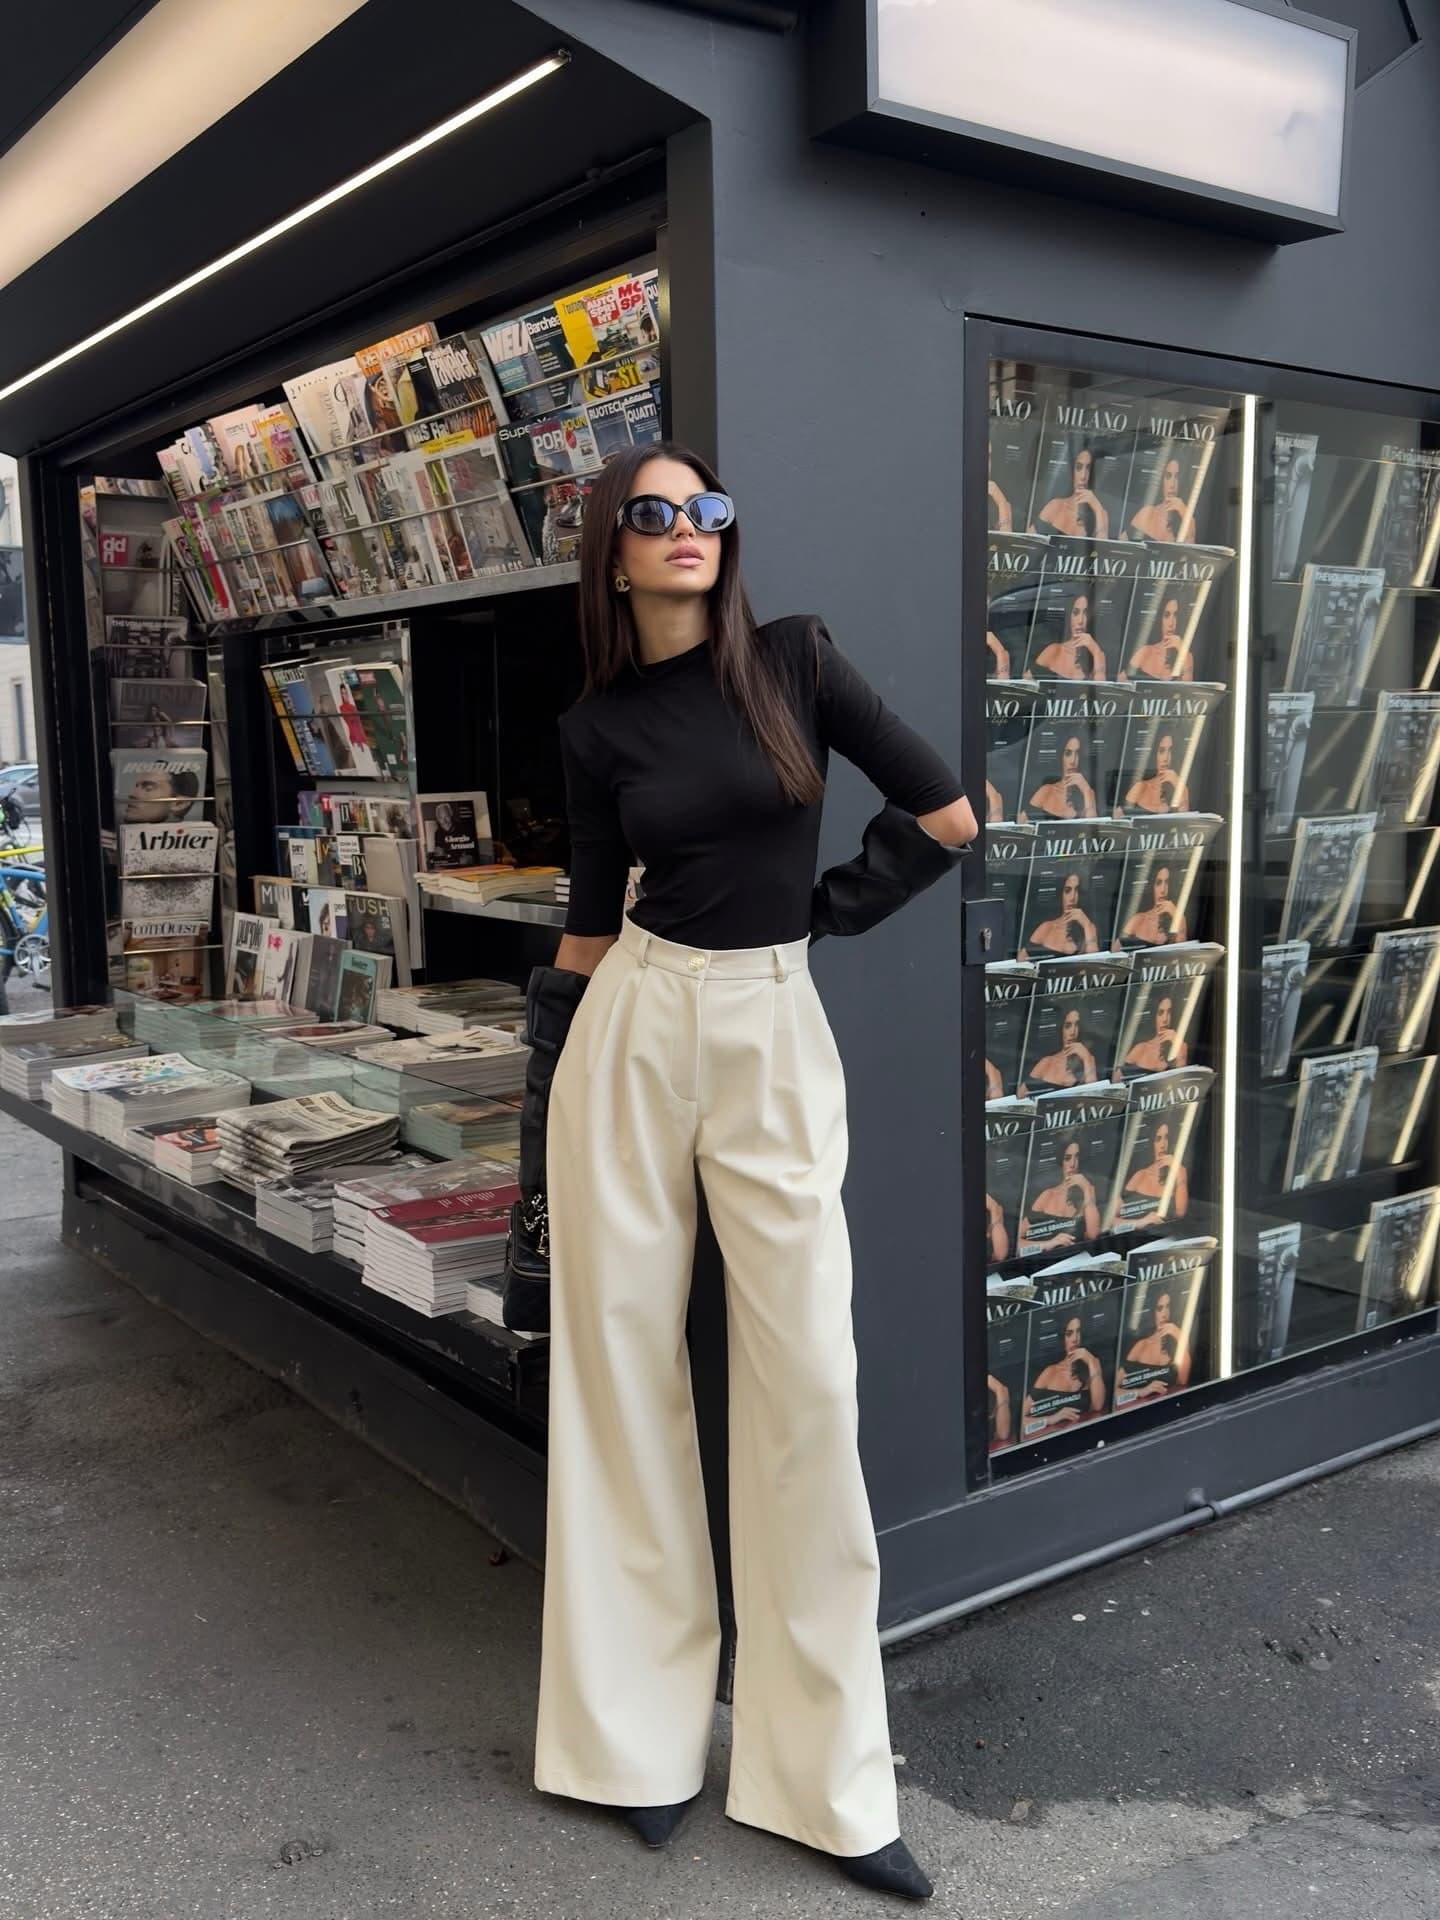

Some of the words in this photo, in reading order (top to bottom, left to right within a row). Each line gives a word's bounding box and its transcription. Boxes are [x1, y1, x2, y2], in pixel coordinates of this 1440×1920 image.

[1056, 406, 1128, 432] MILANO
[1150, 417, 1215, 441] MILANO
[103, 536, 127, 553] dd
[1054, 555, 1126, 577] MILANO
[1148, 560, 1214, 581] MILANO
[1045, 699, 1116, 718] MILANO
[1141, 699, 1207, 717] MILANO
[130, 829, 214, 852] Arbiter
[1045, 838, 1115, 857] MILANO
[1138, 831, 1204, 850] MILANO
[346, 896, 389, 916] TUSH
[235, 919, 263, 950] purple
[1140, 961, 1207, 983] MILANO
[1045, 973, 1115, 995] MILANO
[1137, 1085, 1200, 1111] MILANO
[1043, 1104, 1113, 1129] MILANO
[1136, 1256, 1202, 1283] MILANO
[1042, 1277, 1113, 1307] MILANO
